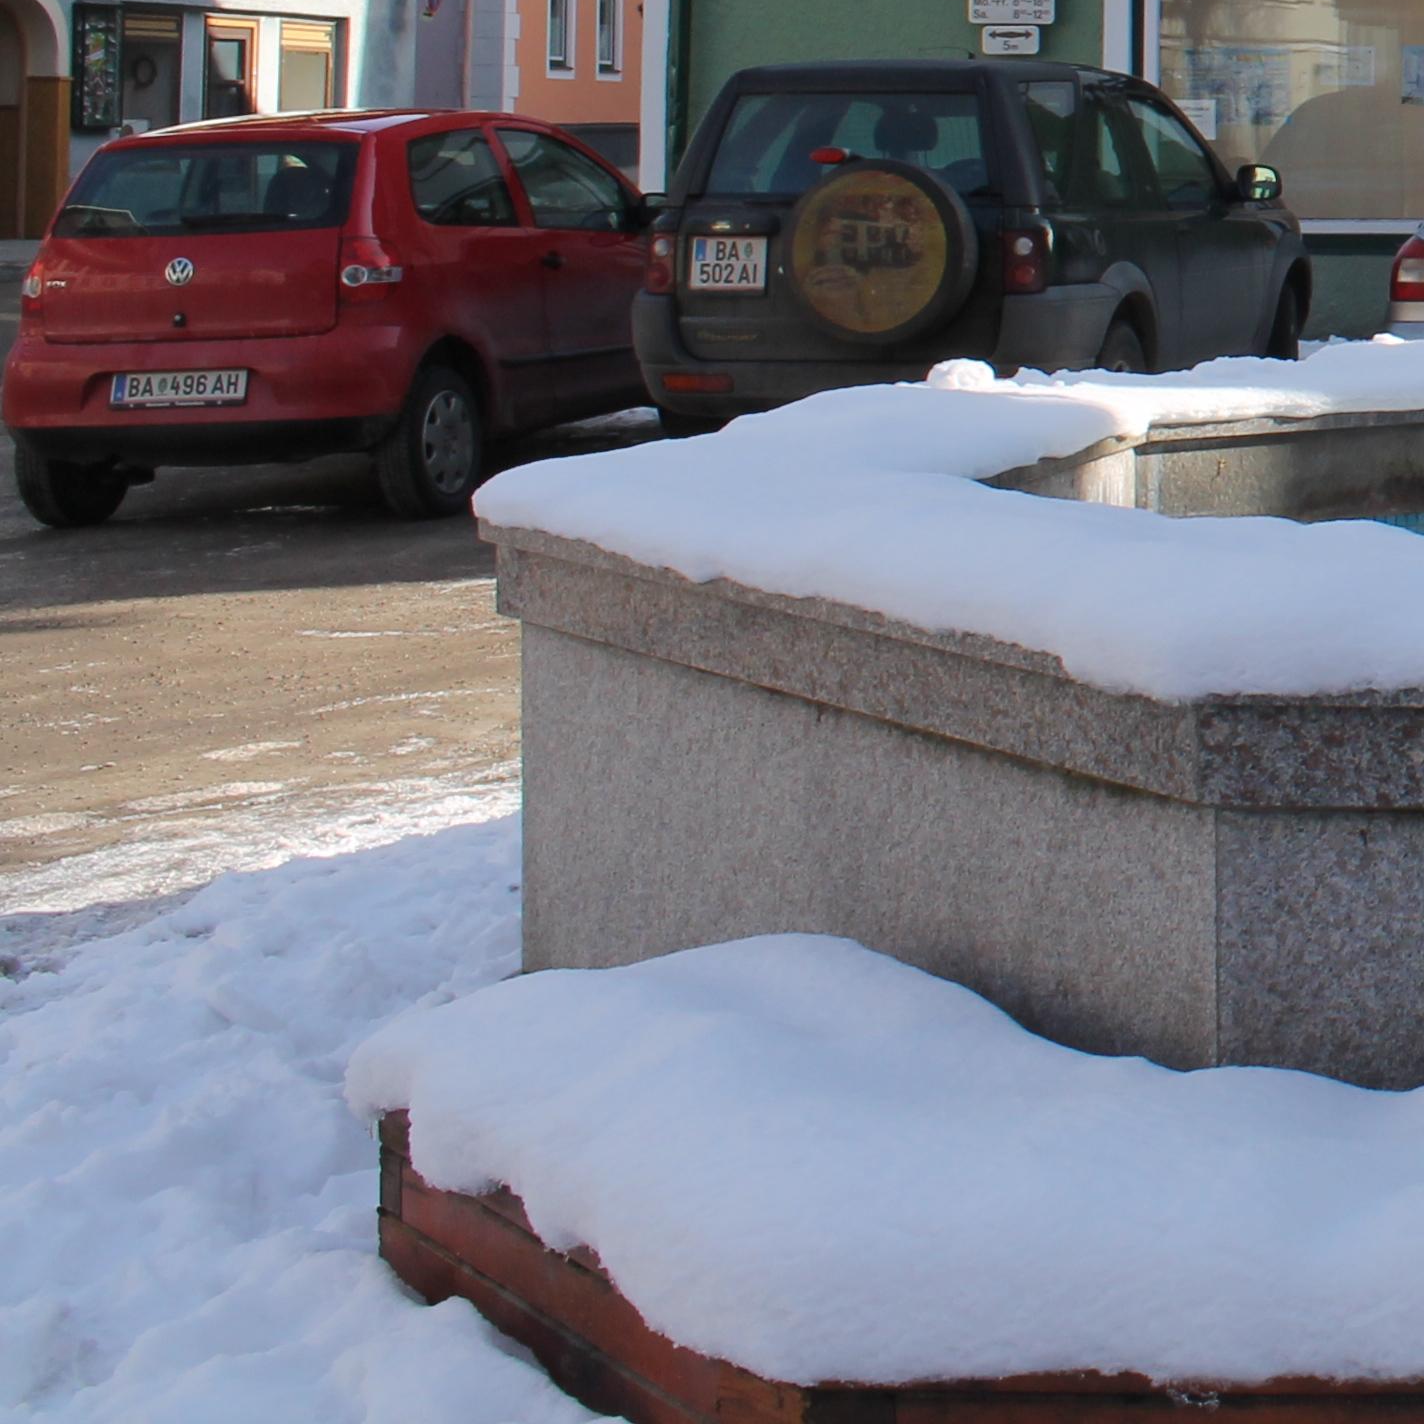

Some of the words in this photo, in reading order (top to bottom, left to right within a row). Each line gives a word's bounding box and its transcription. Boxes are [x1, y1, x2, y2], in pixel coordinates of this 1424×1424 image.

[716, 241, 739, 261] BA
[700, 264, 735, 283] 502
[738, 264, 757, 283] AI
[128, 377, 153, 397] BA
[170, 375, 208, 395] 496
[212, 373, 239, 394] AH
